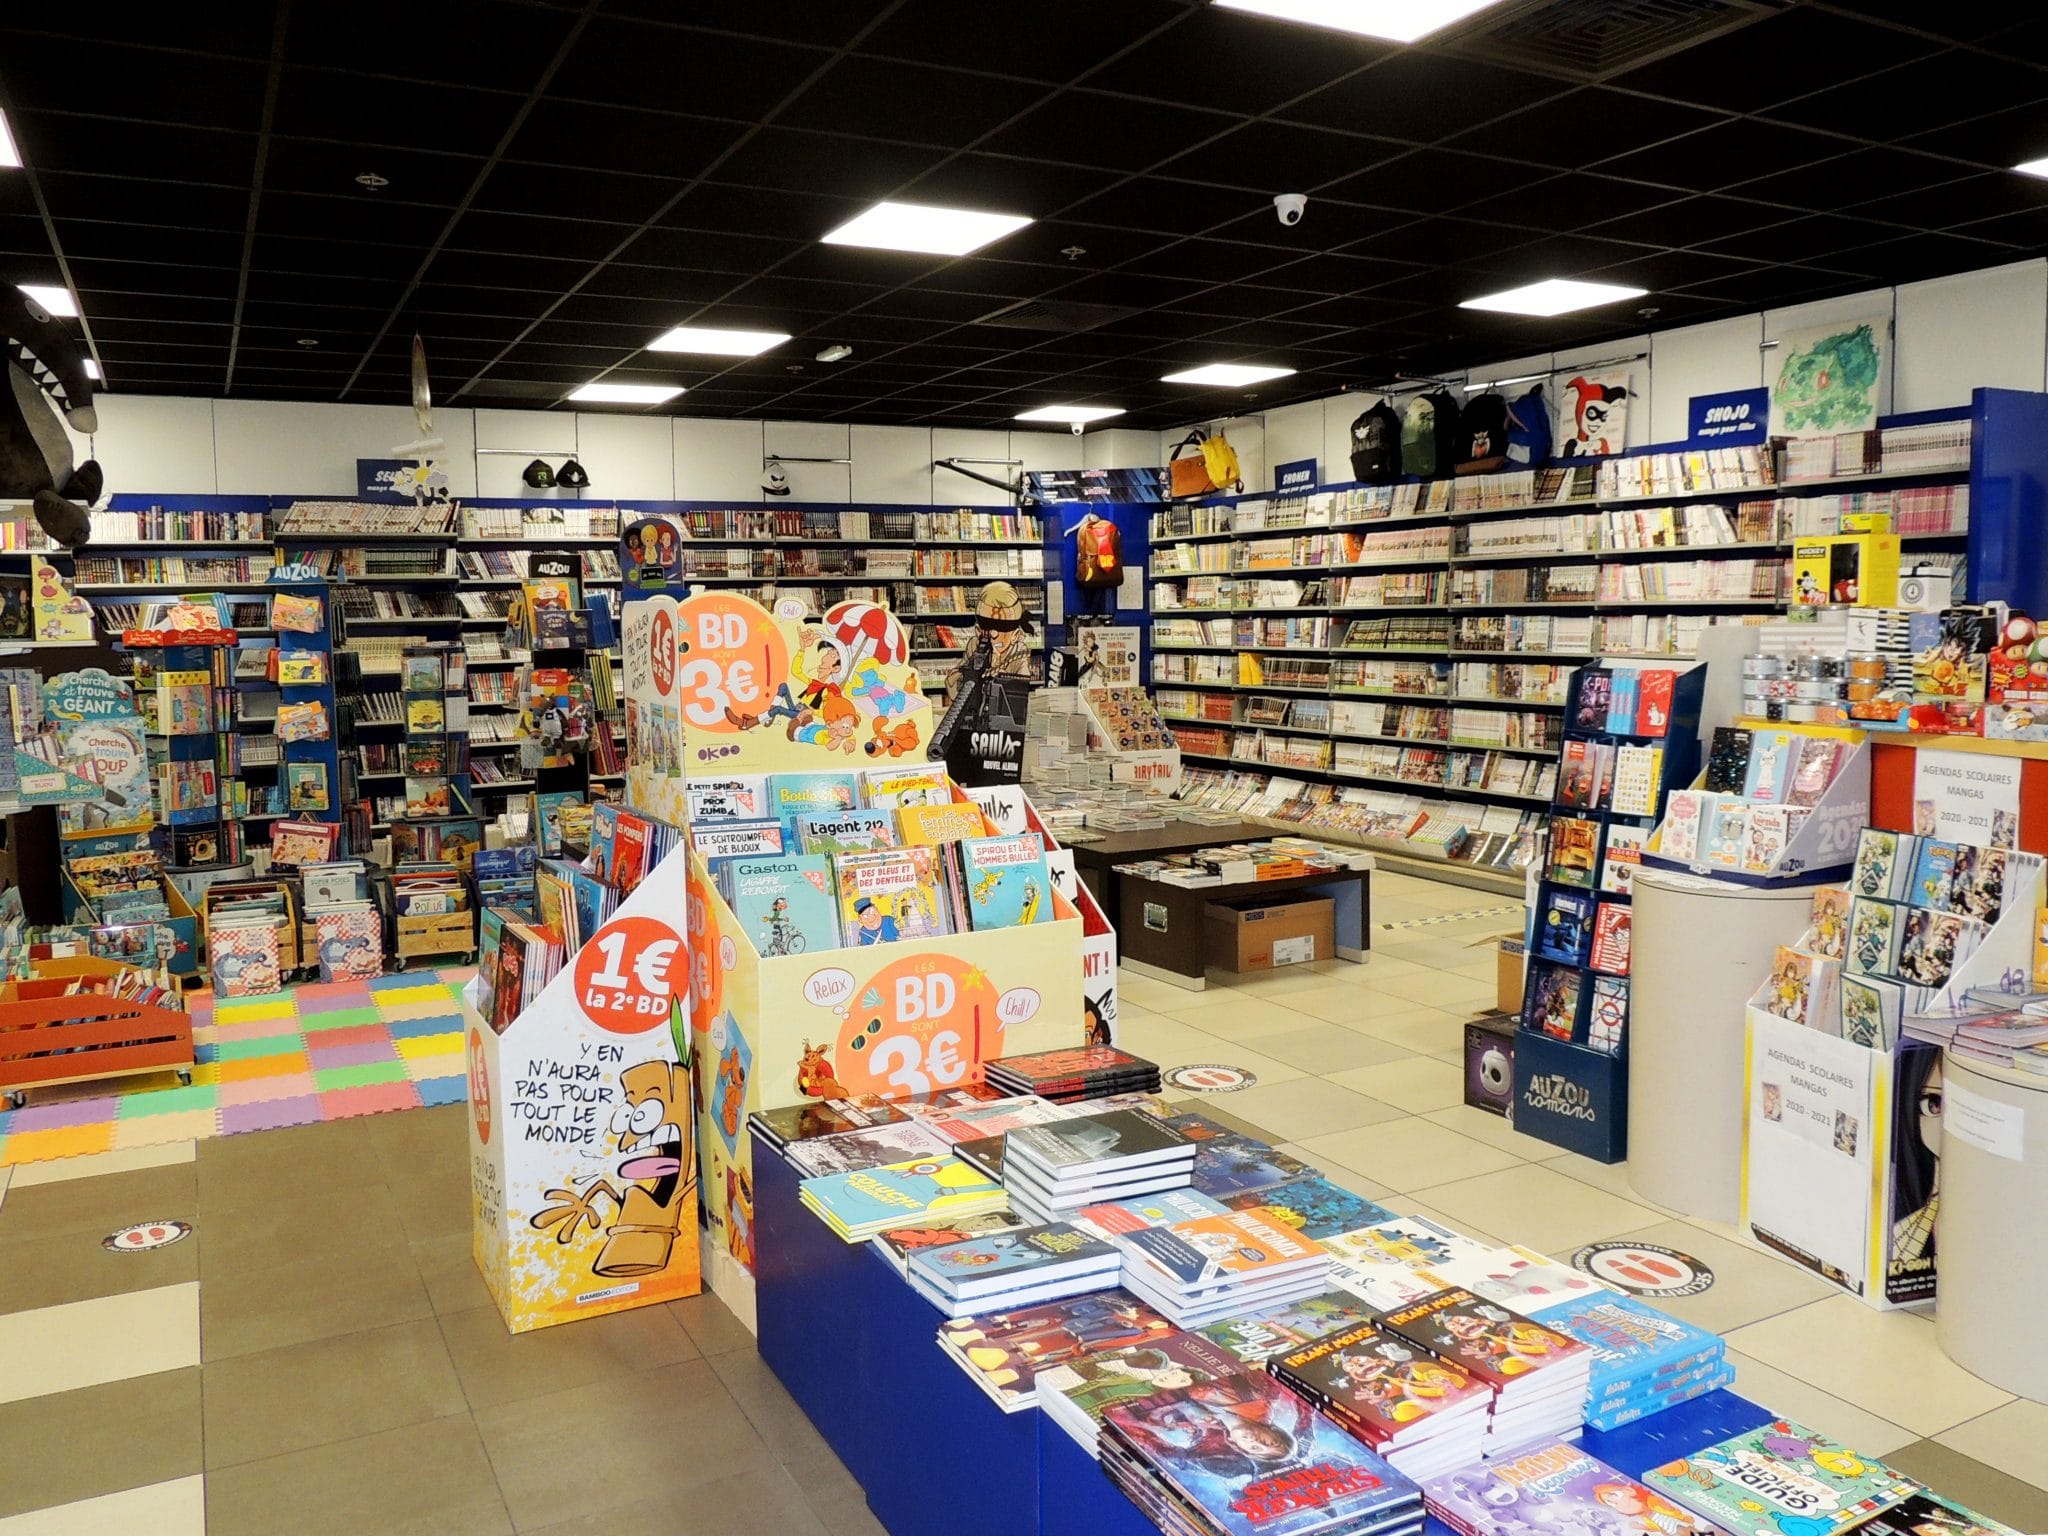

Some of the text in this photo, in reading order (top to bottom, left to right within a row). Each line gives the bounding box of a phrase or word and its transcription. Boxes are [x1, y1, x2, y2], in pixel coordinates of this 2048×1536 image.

[1705, 404, 1750, 424] SHOJO
[1720, 425, 1737, 436] pour
[274, 563, 319, 581] AUZOU
[538, 561, 570, 574] AUZOU
[698, 613, 748, 649] BD
[69, 675, 112, 688] Cherche
[77, 684, 114, 698] trouve
[680, 659, 759, 726] 3€
[63, 697, 115, 714] GÉANT
[88, 738, 127, 748] Cherche
[970, 731, 1021, 758] seuls
[97, 758, 128, 773] OUP
[983, 760, 1018, 771] NOUVEL ALBUM
[1923, 765, 2012, 785] AGENDAS SCOLAIRES
[891, 778, 936, 789] LE PIED-TEN
[1947, 786, 1984, 800] MANGAS
[780, 788, 817, 802] Boule
[810, 820, 861, 836] L'agent
[1941, 812, 1989, 828] 2020 2021
[698, 831, 768, 845] LE SCHTROUMPF
[976, 841, 1029, 855] SPIROU ET LE
[718, 844, 761, 853] DE BIJOUX
[738, 862, 799, 875] Gaston
[862, 865, 910, 877] DES BLEUS ET
[1780, 858, 1806, 872] AUZOU
[860, 874, 914, 887] DES DENTELLES
[590, 931, 680, 995] 1€
[915, 962, 936, 973] LES
[813, 977, 848, 1001] Relax
[895, 973, 956, 1022] BD
[586, 989, 604, 1008] la
[636, 995, 668, 1015] BD
[1005, 999, 1030, 1017] Chill!
[911, 1020, 941, 1033] SONT
[581, 1043, 625, 1063] Y EN
[528, 1060, 601, 1081] N'AURA
[869, 1030, 966, 1100] 3€
[1767, 1048, 1854, 1089] AGENDAS SCOLAIRES
[515, 1081, 614, 1104] PAS POUR
[1529, 1074, 1590, 1107] AUZOU
[1790, 1074, 1828, 1097] MANGAS
[510, 1102, 598, 1123] TOUT LE
[1523, 1091, 1596, 1122] romans
[1786, 1099, 1831, 1127] 2020 2021
[525, 1124, 596, 1144] MONDE
[1164, 1191, 1217, 1219] PHILOCO
[1224, 1212, 1307, 1259] PHILOCOMIX
[578, 1289, 611, 1302] BAMBOO
[1431, 1290, 1474, 1311] MOUSE
[1331, 1326, 1376, 1349] MOUSE
[1180, 1340, 1214, 1367] NELLIE
[1725, 1467, 1808, 1510] GUIDE
[1741, 1462, 1820, 1503] OFFICIEL
